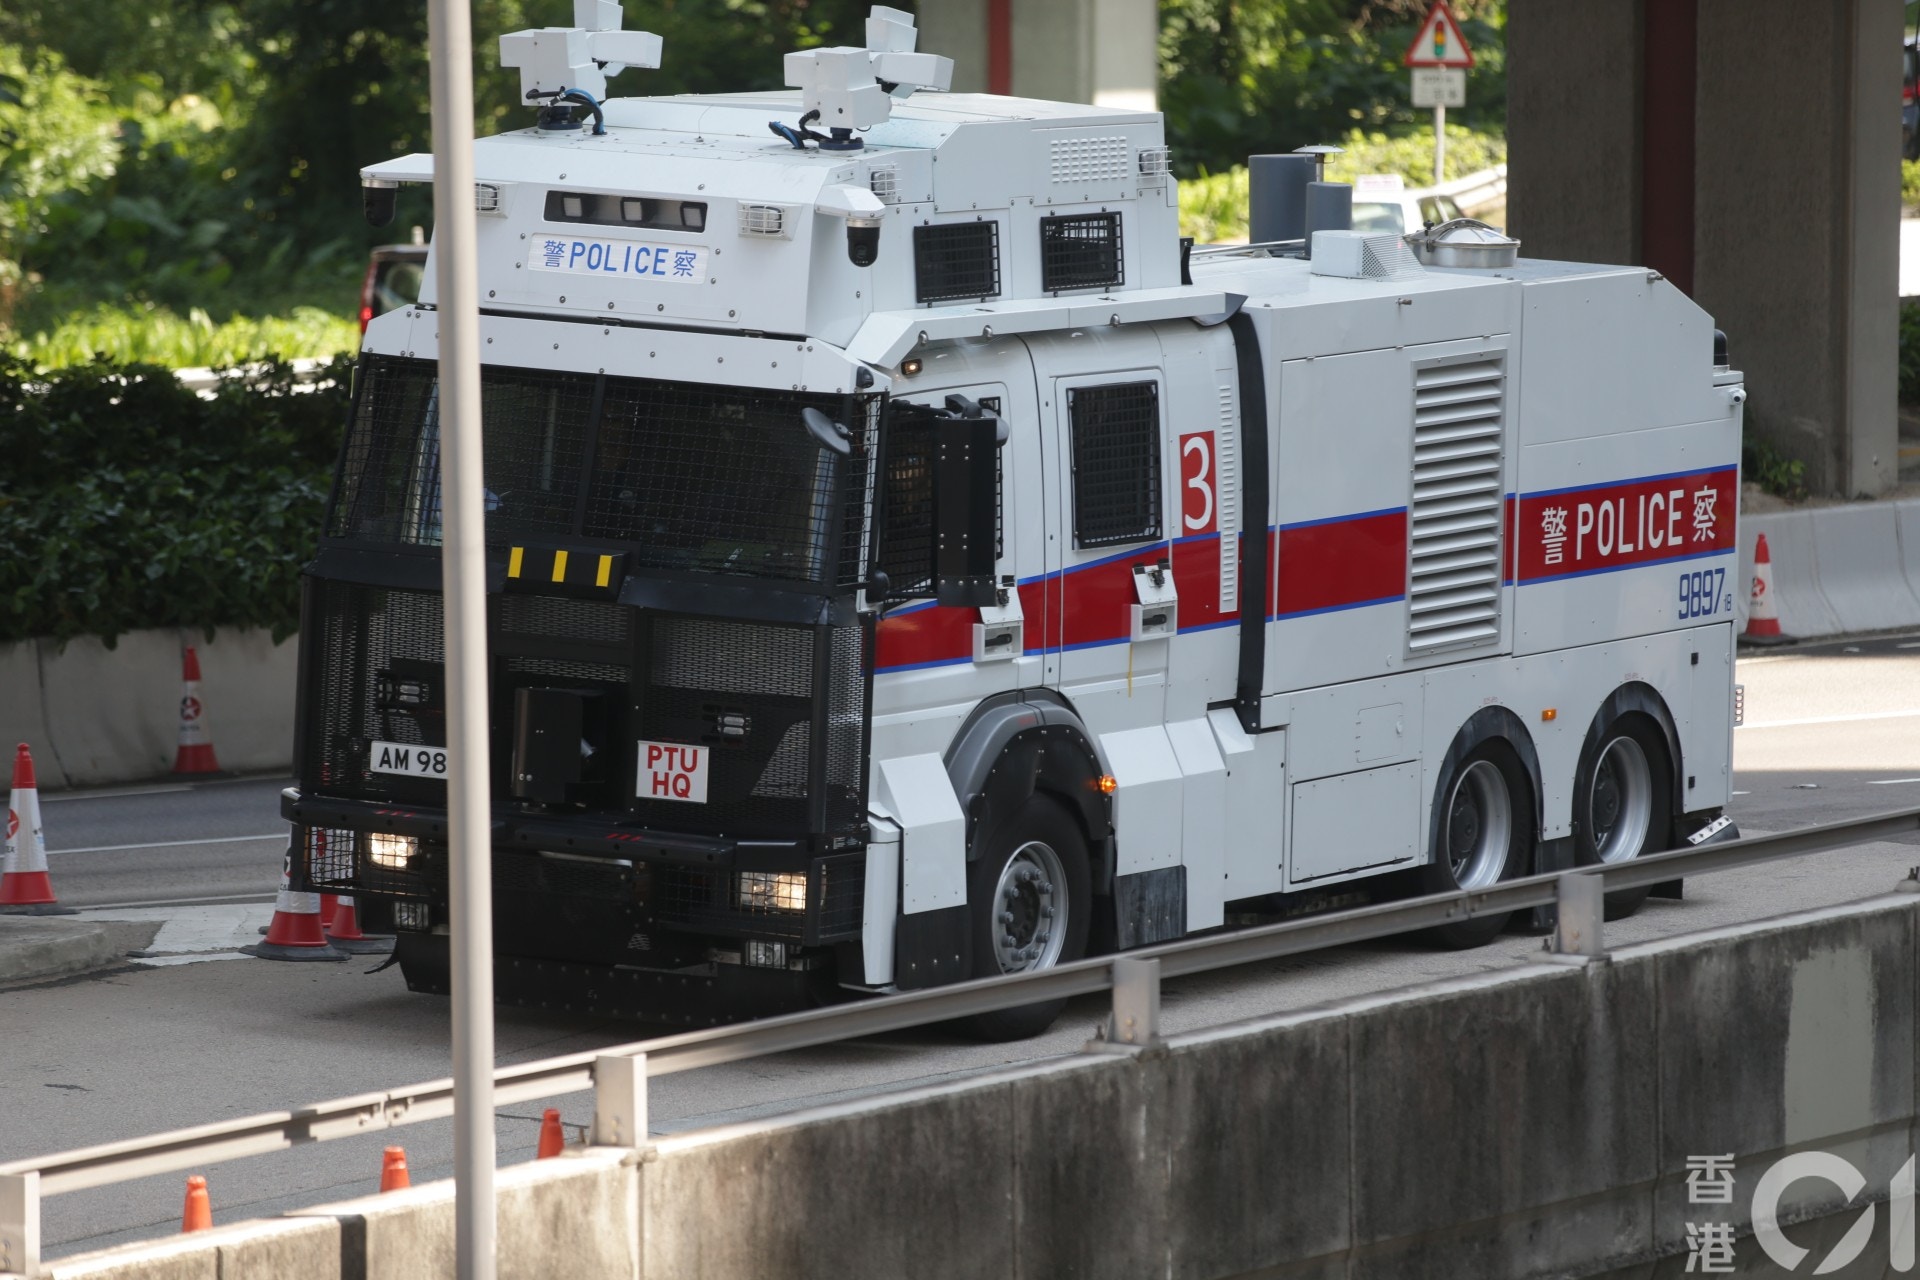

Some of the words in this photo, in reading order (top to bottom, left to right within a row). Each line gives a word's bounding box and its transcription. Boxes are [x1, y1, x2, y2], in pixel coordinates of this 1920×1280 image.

[543, 239, 566, 268] 警
[569, 241, 669, 276] POLICE
[673, 249, 697, 277] 察
[1184, 436, 1213, 530] 3
[1541, 506, 1568, 565] 警
[1575, 489, 1685, 561] POLICE
[1692, 485, 1718, 543] 察
[1678, 567, 1726, 620] 9897
[378, 746, 410, 771] AM
[417, 751, 447, 775] 98
[646, 744, 699, 773] PTU
[651, 771, 692, 799] HQ
